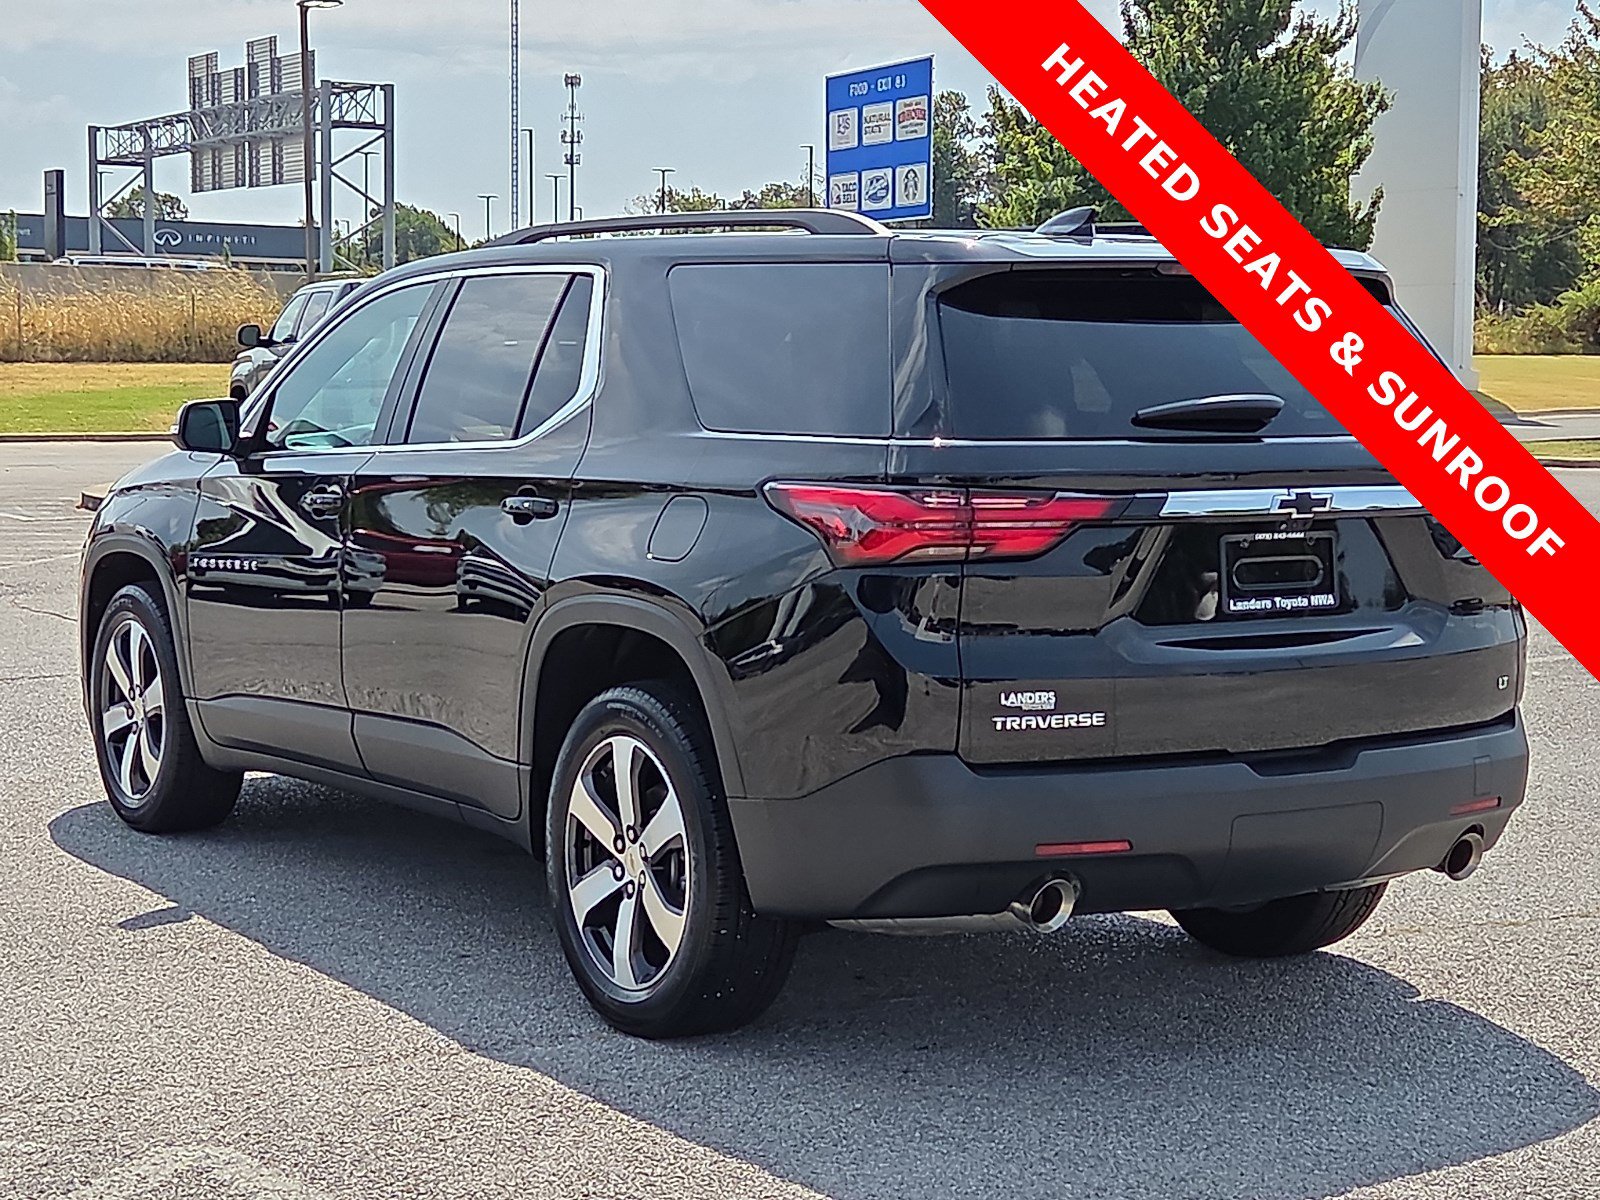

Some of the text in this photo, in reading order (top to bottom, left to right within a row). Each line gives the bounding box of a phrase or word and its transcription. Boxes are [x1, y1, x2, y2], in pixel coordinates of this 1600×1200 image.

[849, 81, 869, 97] FOOD
[877, 76, 892, 92] EXIT
[863, 112, 892, 124] NATURAL
[863, 125, 882, 136] STATE
[841, 182, 857, 193] TACO
[842, 193, 857, 204] BELL
[188, 234, 256, 245] INFINITI
[1229, 594, 1335, 611] Landers Toyota NWA
[1498, 676, 1509, 690] LT
[1000, 691, 1056, 706] LANDERS
[991, 712, 1106, 731] TRAVERSE
